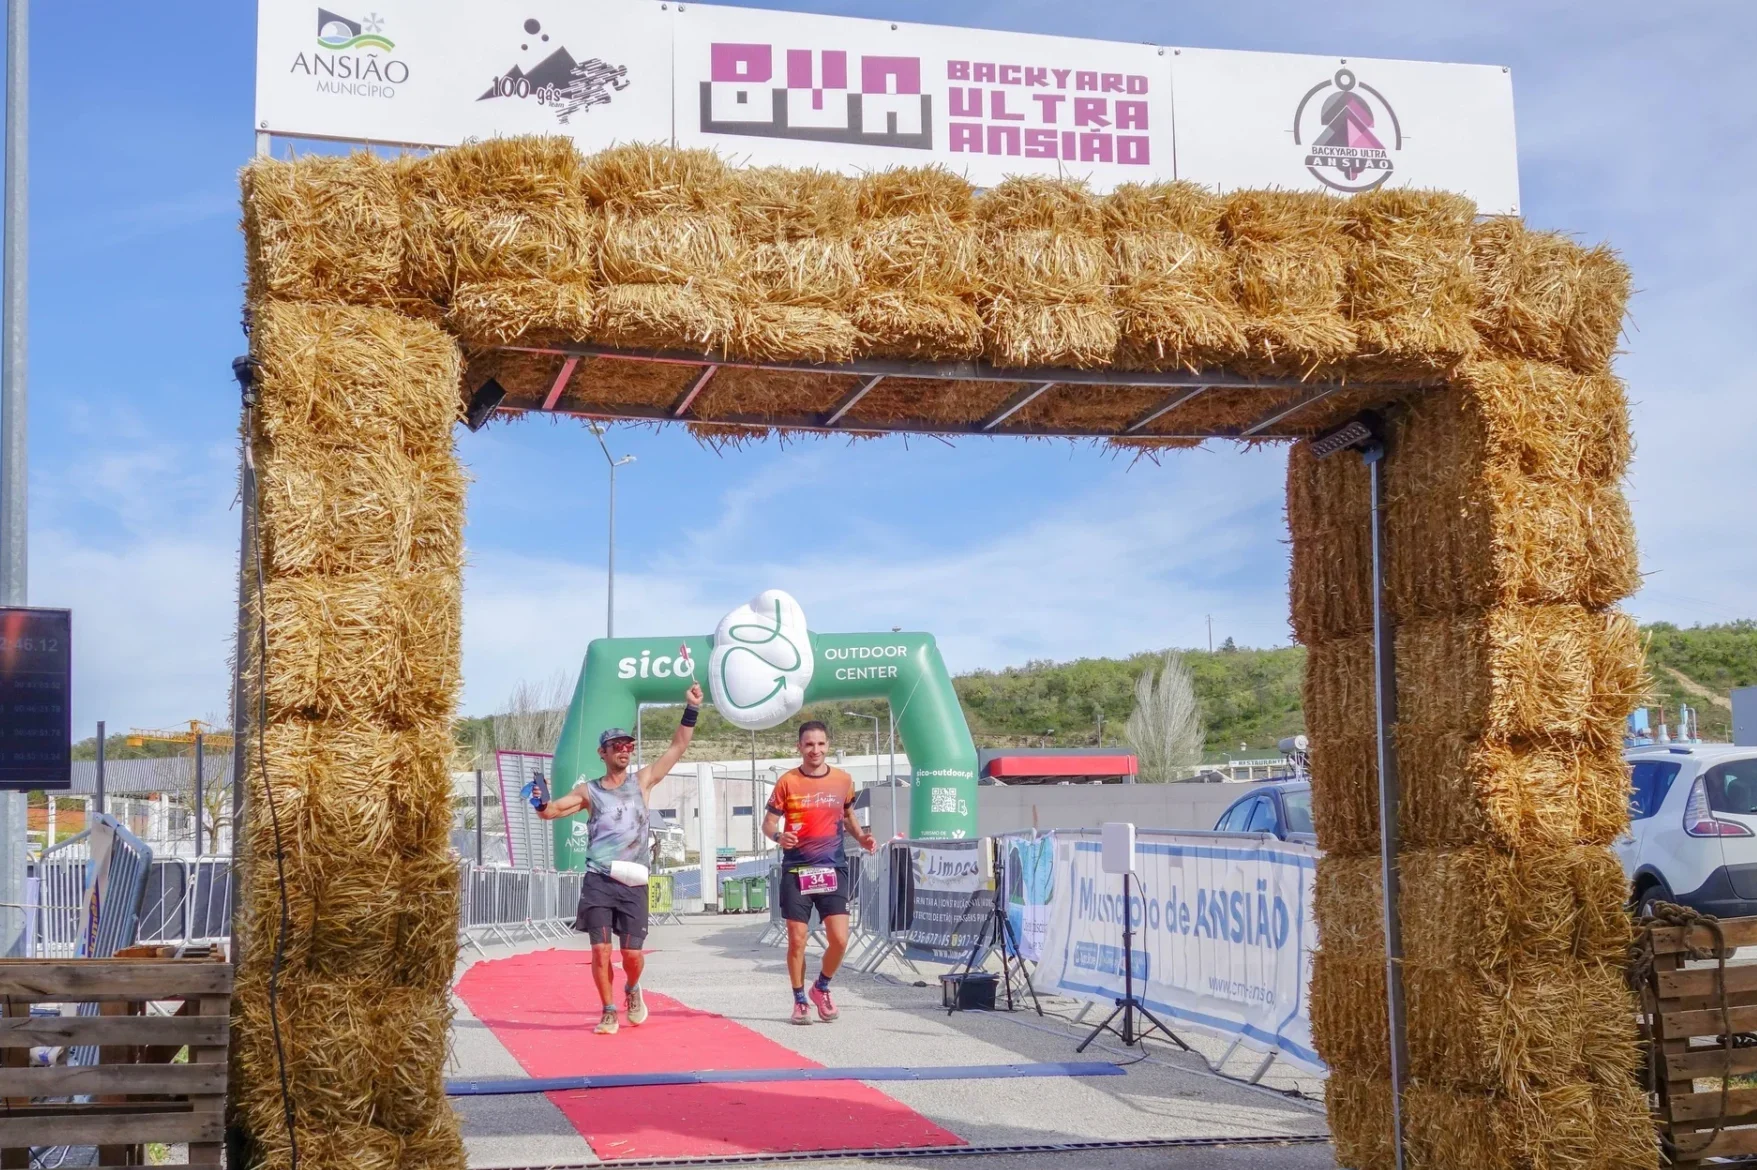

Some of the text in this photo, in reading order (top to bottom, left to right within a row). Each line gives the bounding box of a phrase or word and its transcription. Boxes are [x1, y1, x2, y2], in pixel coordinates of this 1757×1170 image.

[290, 52, 409, 84] ANSIÃO
[947, 60, 1149, 95] BACKYARD
[316, 80, 395, 98] MUNICÍPIO
[492, 76, 561, 105] 100 gás
[949, 87, 1149, 130] ULTRA
[949, 122, 1150, 165] ANSIÃO
[1312, 147, 1387, 158] BACKYARD ULTRA
[825, 645, 907, 660] OUTDOOR
[835, 665, 898, 680] CENTER
[810, 874, 825, 885] 34
[1165, 885, 1190, 935] de
